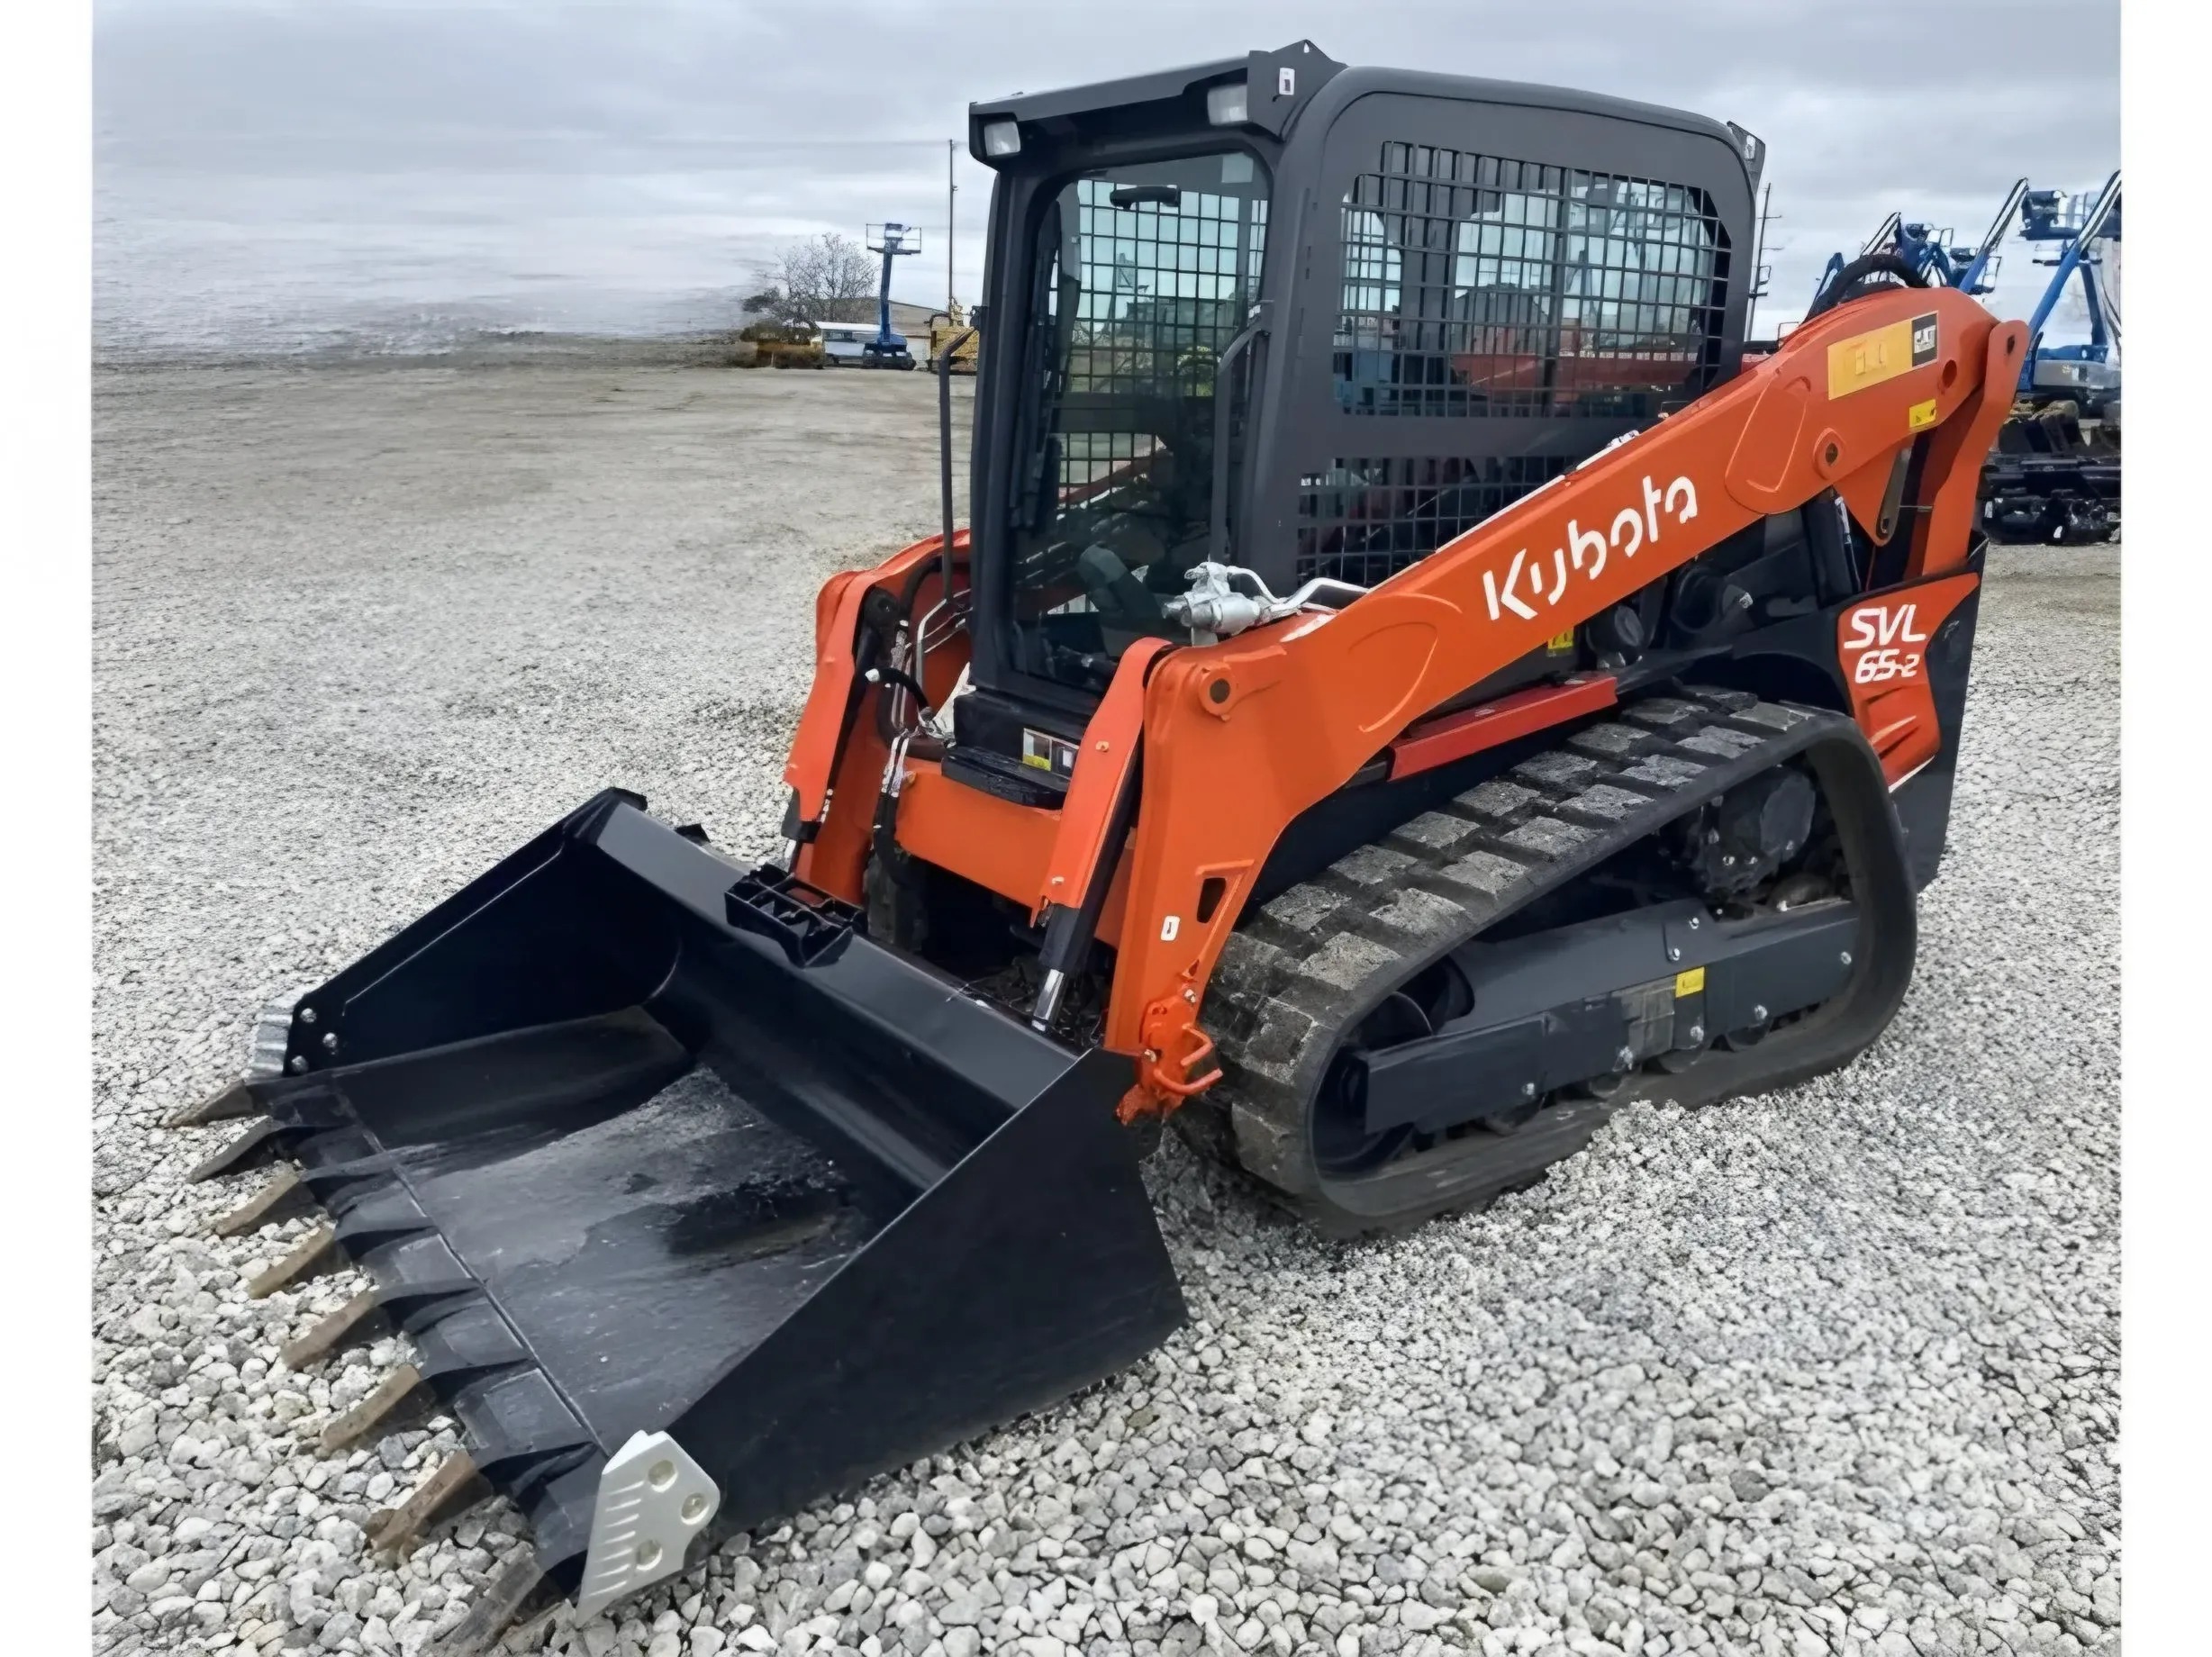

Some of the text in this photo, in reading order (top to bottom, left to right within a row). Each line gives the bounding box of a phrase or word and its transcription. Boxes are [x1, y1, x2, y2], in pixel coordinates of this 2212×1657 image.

[1482, 475, 1698, 620] Kubota
[1844, 604, 1926, 648] SVL
[1855, 648, 1920, 684] 65-2
